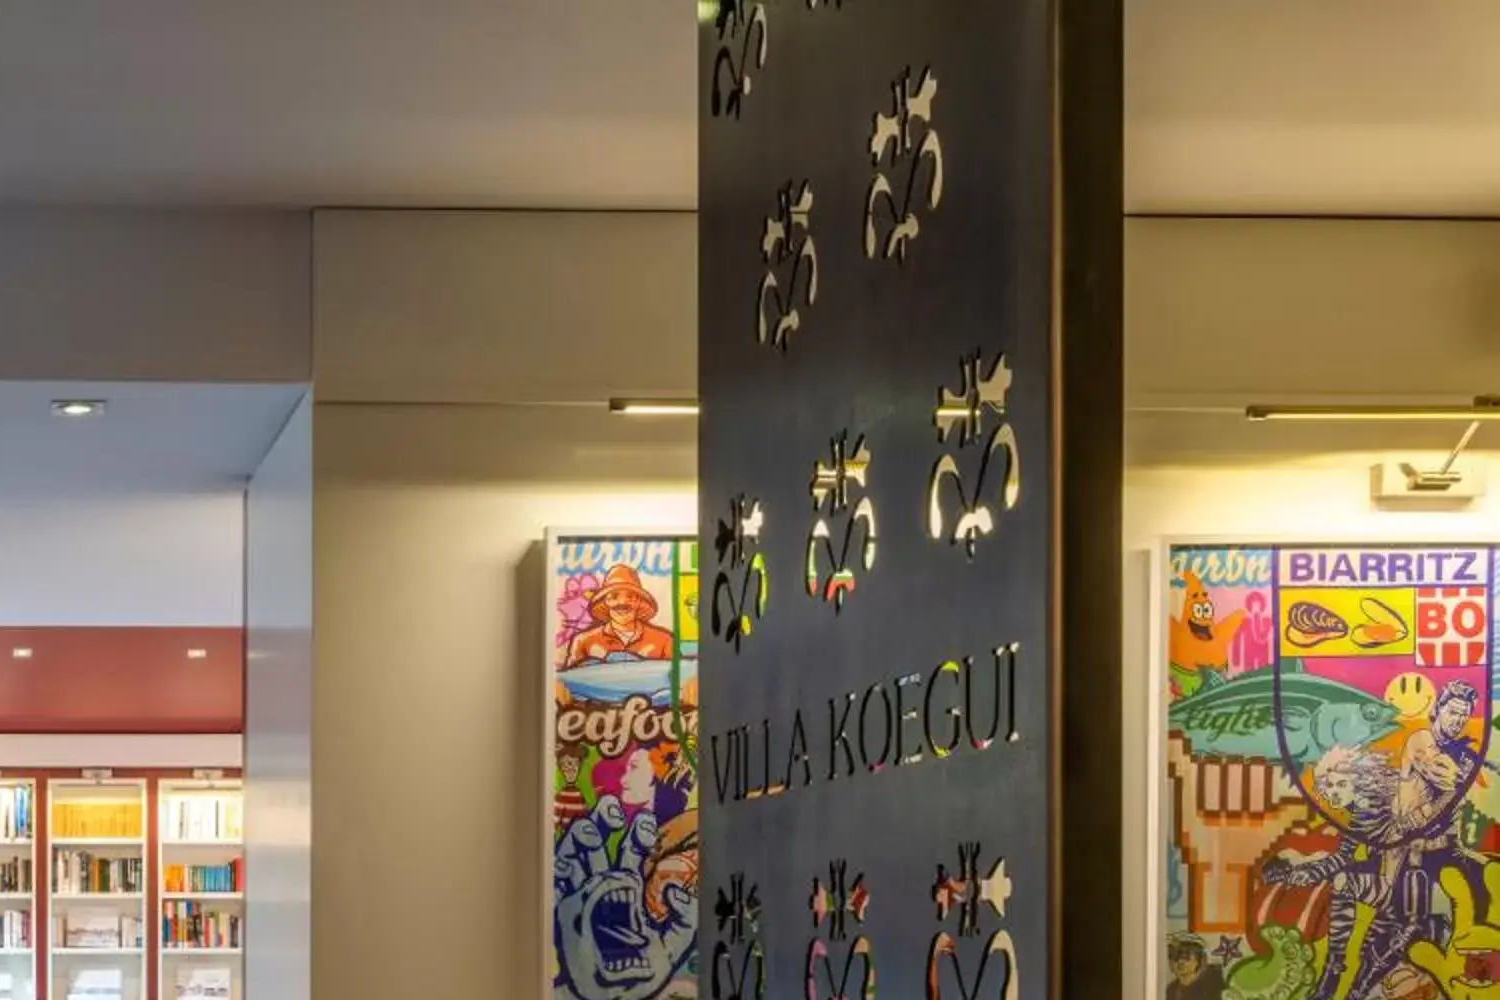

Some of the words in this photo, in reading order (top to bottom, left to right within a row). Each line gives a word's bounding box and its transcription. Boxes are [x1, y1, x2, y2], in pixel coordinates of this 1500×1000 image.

[1289, 552, 1477, 582] BIARRITZ
[1418, 602, 1485, 638] BO
[555, 697, 698, 756] eafoo
[711, 708, 812, 805] VILLA
[828, 642, 1021, 781] KOEGUI
